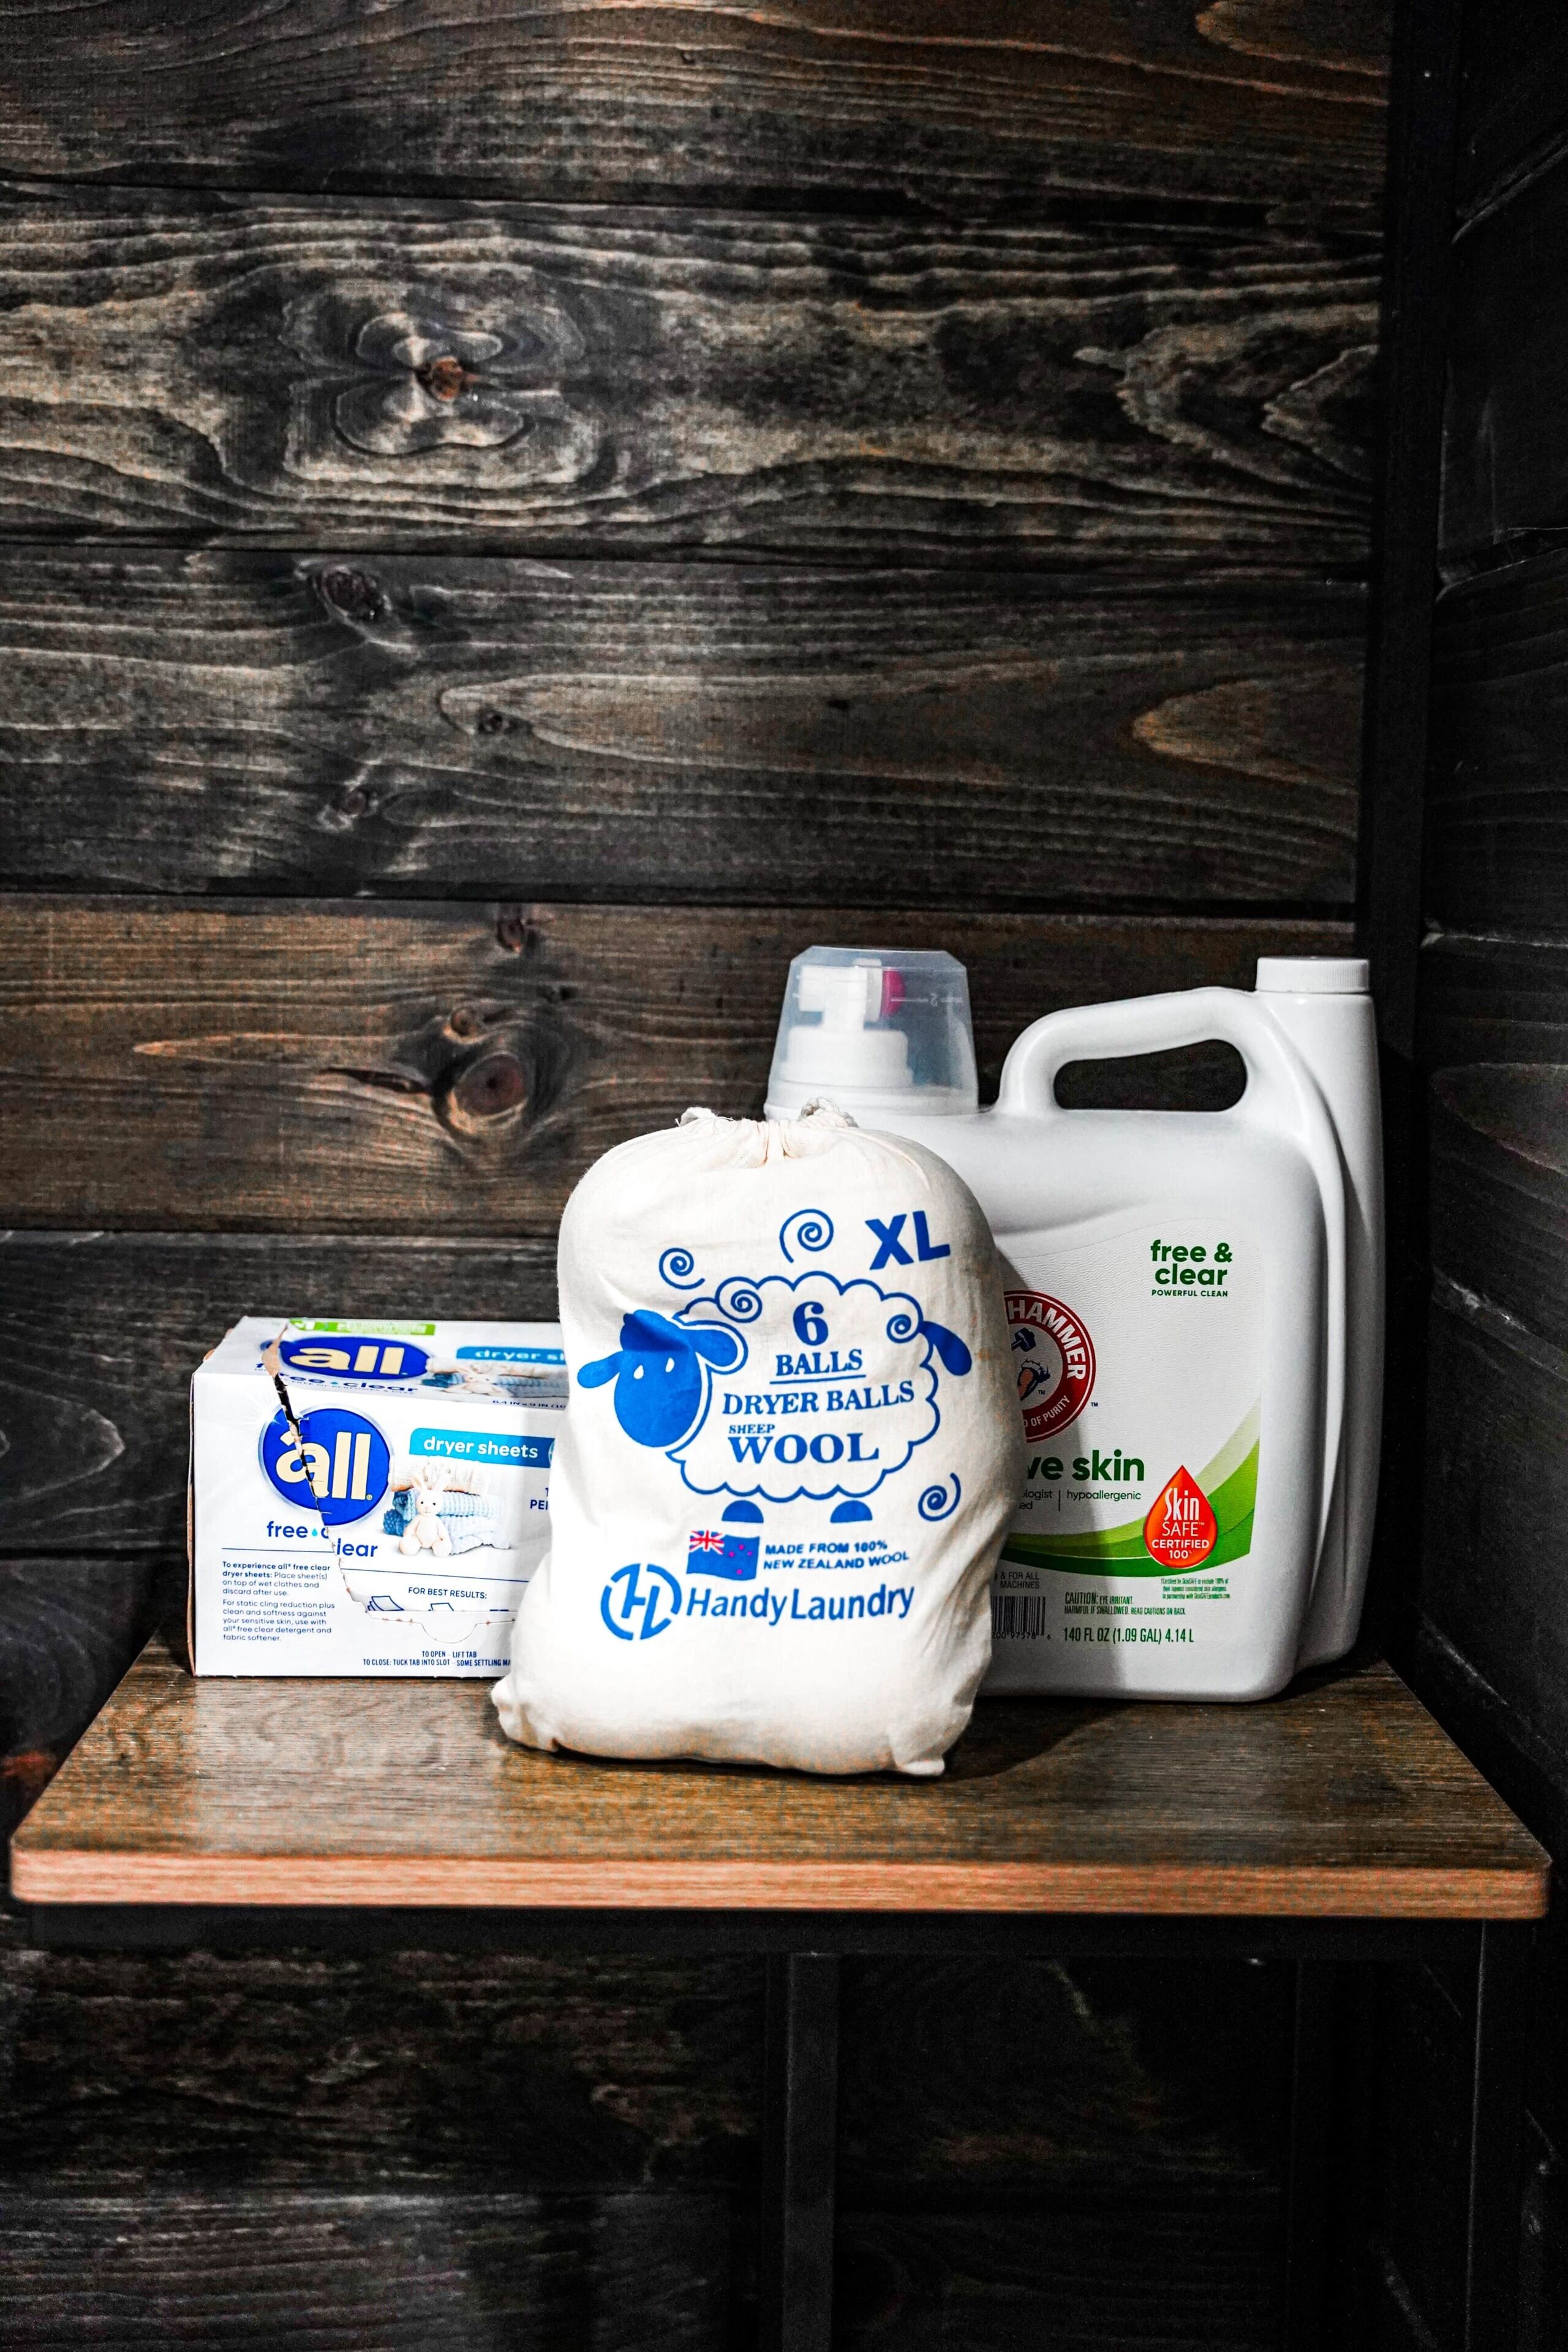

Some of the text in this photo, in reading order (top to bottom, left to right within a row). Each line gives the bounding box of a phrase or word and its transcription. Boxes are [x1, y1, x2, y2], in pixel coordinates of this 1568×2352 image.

[865, 1210, 951, 1270] XL
[1150, 1239, 1233, 1262] free &
[1155, 1263, 1227, 1285] clear
[793, 1301, 829, 1346] 6
[1008, 1300, 1087, 1380] HAMMER
[475, 1349, 540, 1360] dryer
[775, 1349, 863, 1376] BALLS
[343, 1382, 418, 1392] clear
[722, 1381, 914, 1415] DRYER BALLS
[1030, 1415, 1041, 1427] OF
[1043, 1395, 1070, 1422] PURITY
[729, 1424, 775, 1434] SHEEP
[423, 1436, 538, 1458] dryer sheets
[728, 1433, 879, 1464] WOOL
[1072, 1449, 1144, 1481] skin
[1067, 1490, 1141, 1501] hypoallergenic
[1164, 1488, 1199, 1521] Skin
[267, 1521, 307, 1539] free
[765, 1540, 888, 1555] MADE FROM 100%
[1152, 1539, 1210, 1548] CERTIFIED
[763, 1550, 910, 1569] NEW ZEALAND WOOL
[1000, 1571, 1006, 1580] &
[260, 1600, 279, 1608] cling
[450, 1590, 488, 1599] RESULTS:
[1065, 1592, 1098, 1605] CAUTION:
[1099, 1596, 1109, 1605] EYE
[1064, 1627, 1194, 1645] 140 FL OZ (1.09 GAL) 4.14 L
